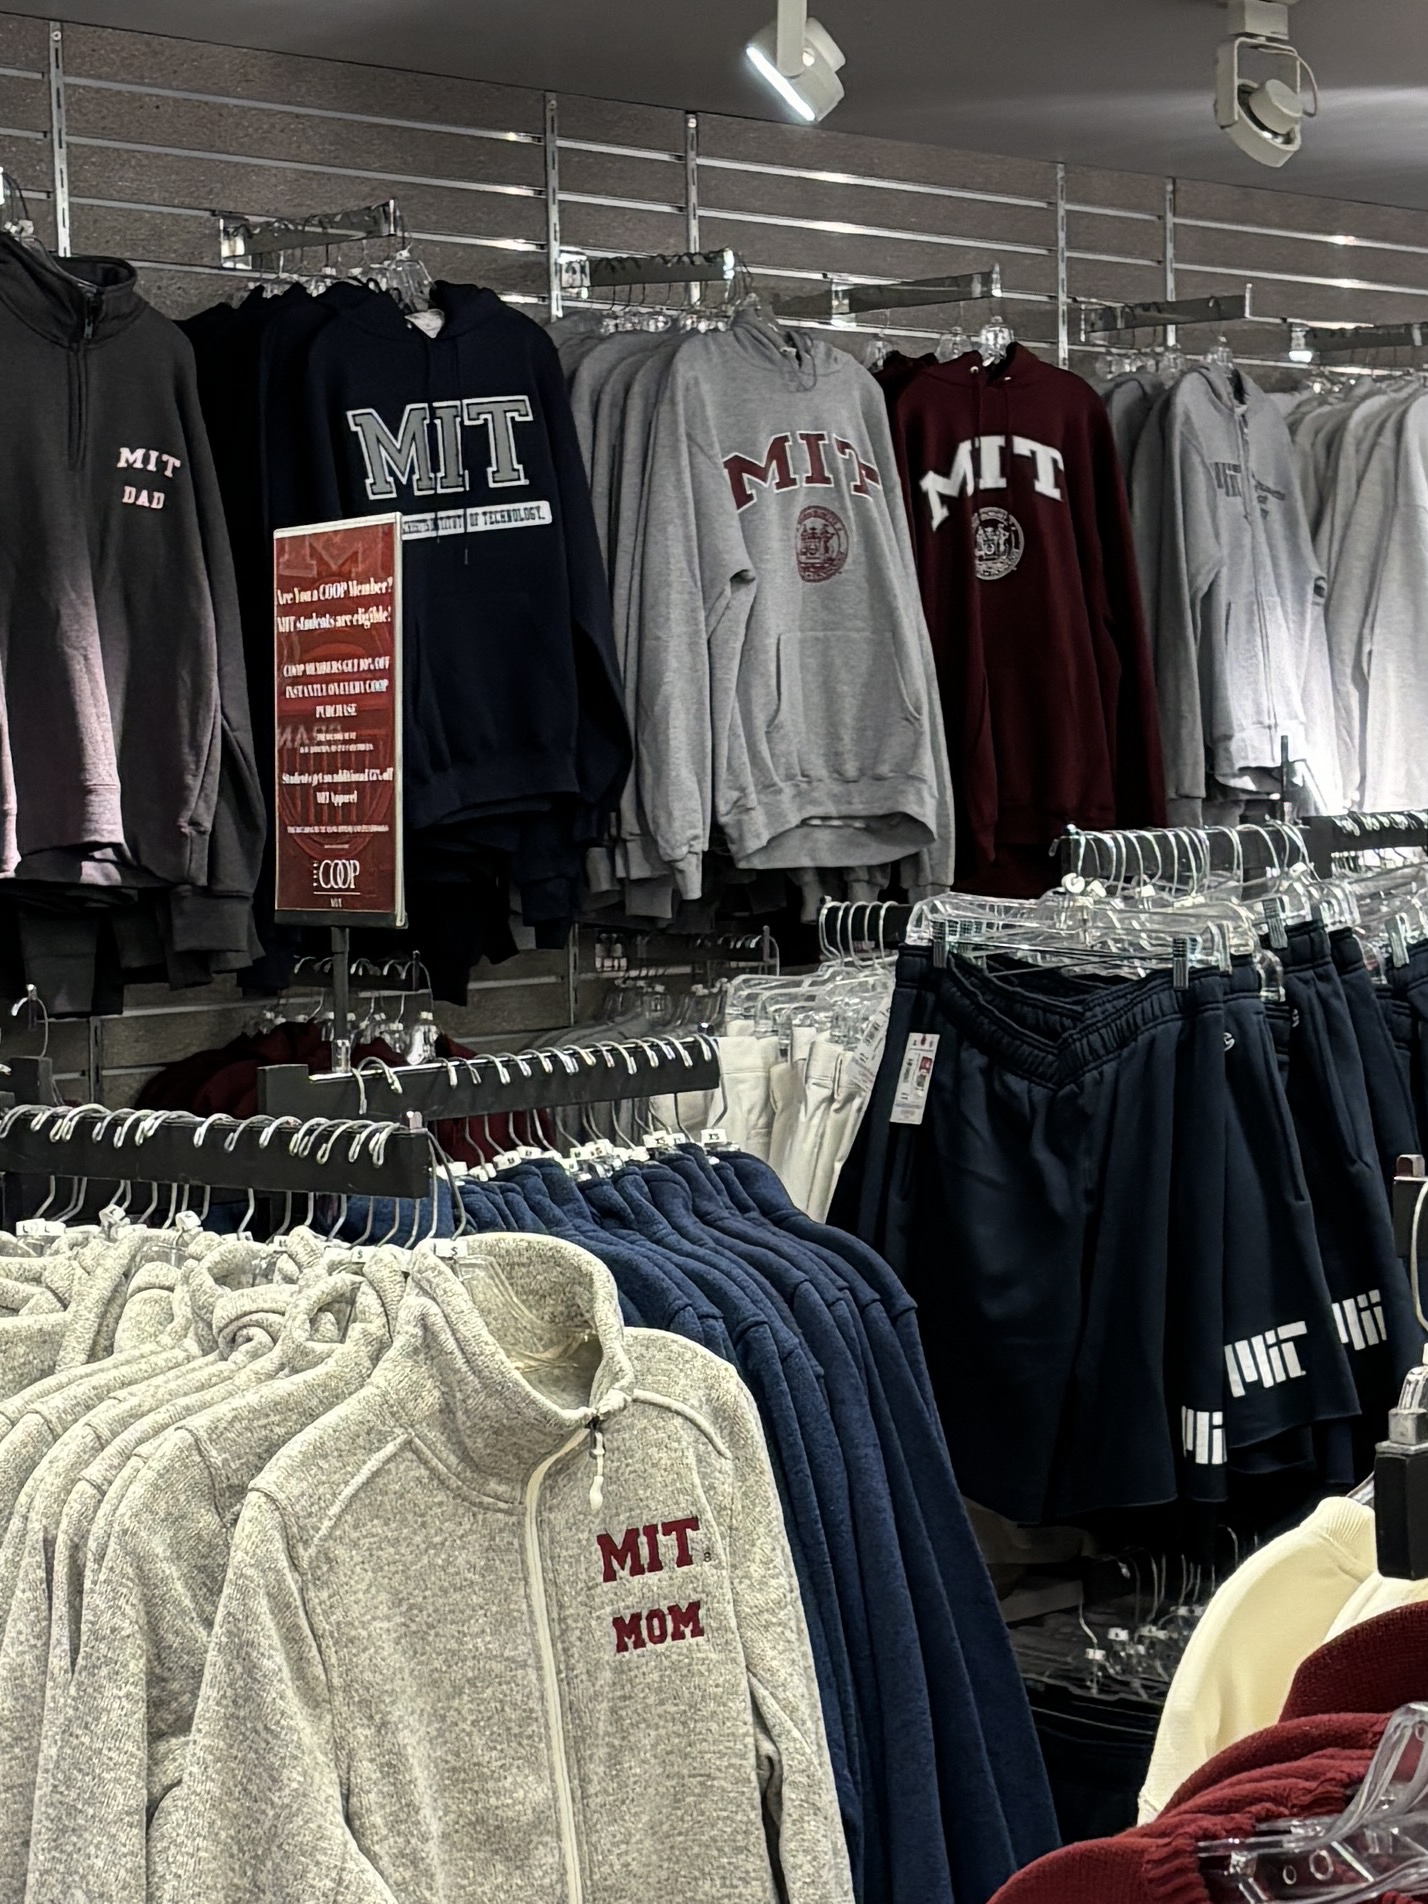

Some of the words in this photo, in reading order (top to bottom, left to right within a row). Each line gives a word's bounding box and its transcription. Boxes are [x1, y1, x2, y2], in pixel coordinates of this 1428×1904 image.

[116, 447, 182, 478] MIT
[347, 395, 534, 500] MIT
[723, 431, 881, 513] MIT
[919, 435, 1064, 532] MIT
[122, 485, 166, 509] DAD
[319, 582, 347, 600] COOP
[349, 576, 393, 597] Member?
[296, 612, 335, 631] students
[335, 615, 352, 628] are
[352, 606, 392, 629] eligible!
[319, 859, 361, 889] COOP
[597, 1516, 701, 1584] MIT
[612, 1600, 705, 1654] MOM
